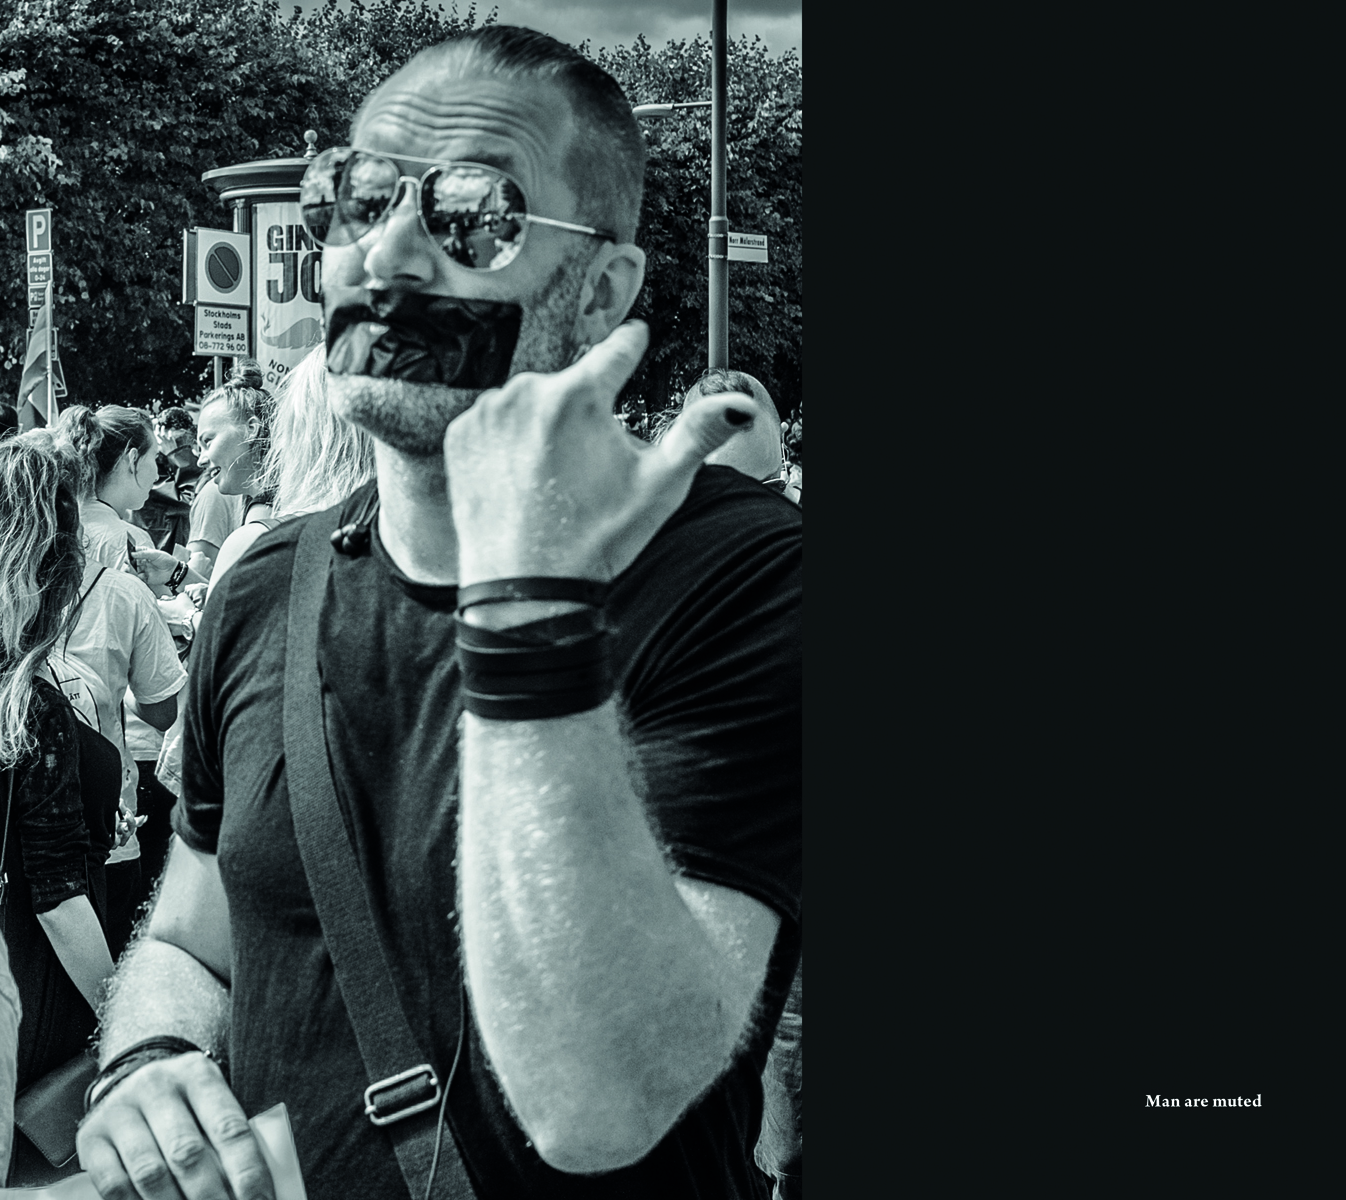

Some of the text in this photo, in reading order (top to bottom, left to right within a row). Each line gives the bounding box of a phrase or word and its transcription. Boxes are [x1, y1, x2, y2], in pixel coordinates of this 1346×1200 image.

[33, 214, 46, 248] P
[204, 309, 241, 320] Stockholms
[213, 320, 232, 330] Stads
[200, 330, 234, 342] Parkerings
[199, 342, 224, 350] 08-772
[226, 343, 234, 351] 96
